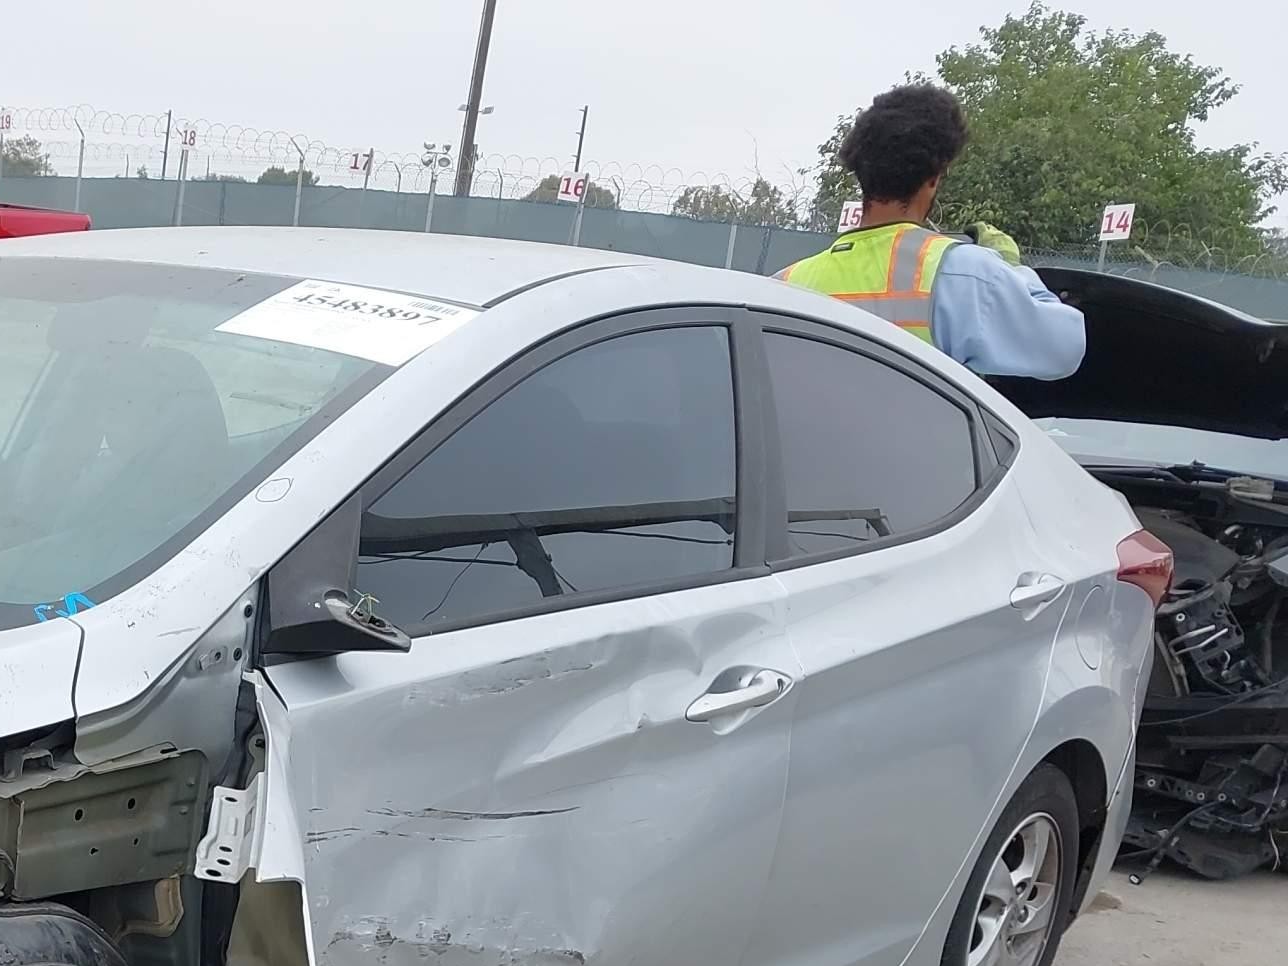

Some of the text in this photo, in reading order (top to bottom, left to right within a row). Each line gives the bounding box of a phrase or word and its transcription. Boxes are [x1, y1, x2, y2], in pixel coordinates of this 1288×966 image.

[0, 114, 11, 130] 19
[182, 129, 196, 146] 18
[560, 177, 585, 197] 16
[839, 207, 863, 227] 15
[1102, 210, 1130, 234] 14
[292, 293, 441, 326] 45483897
